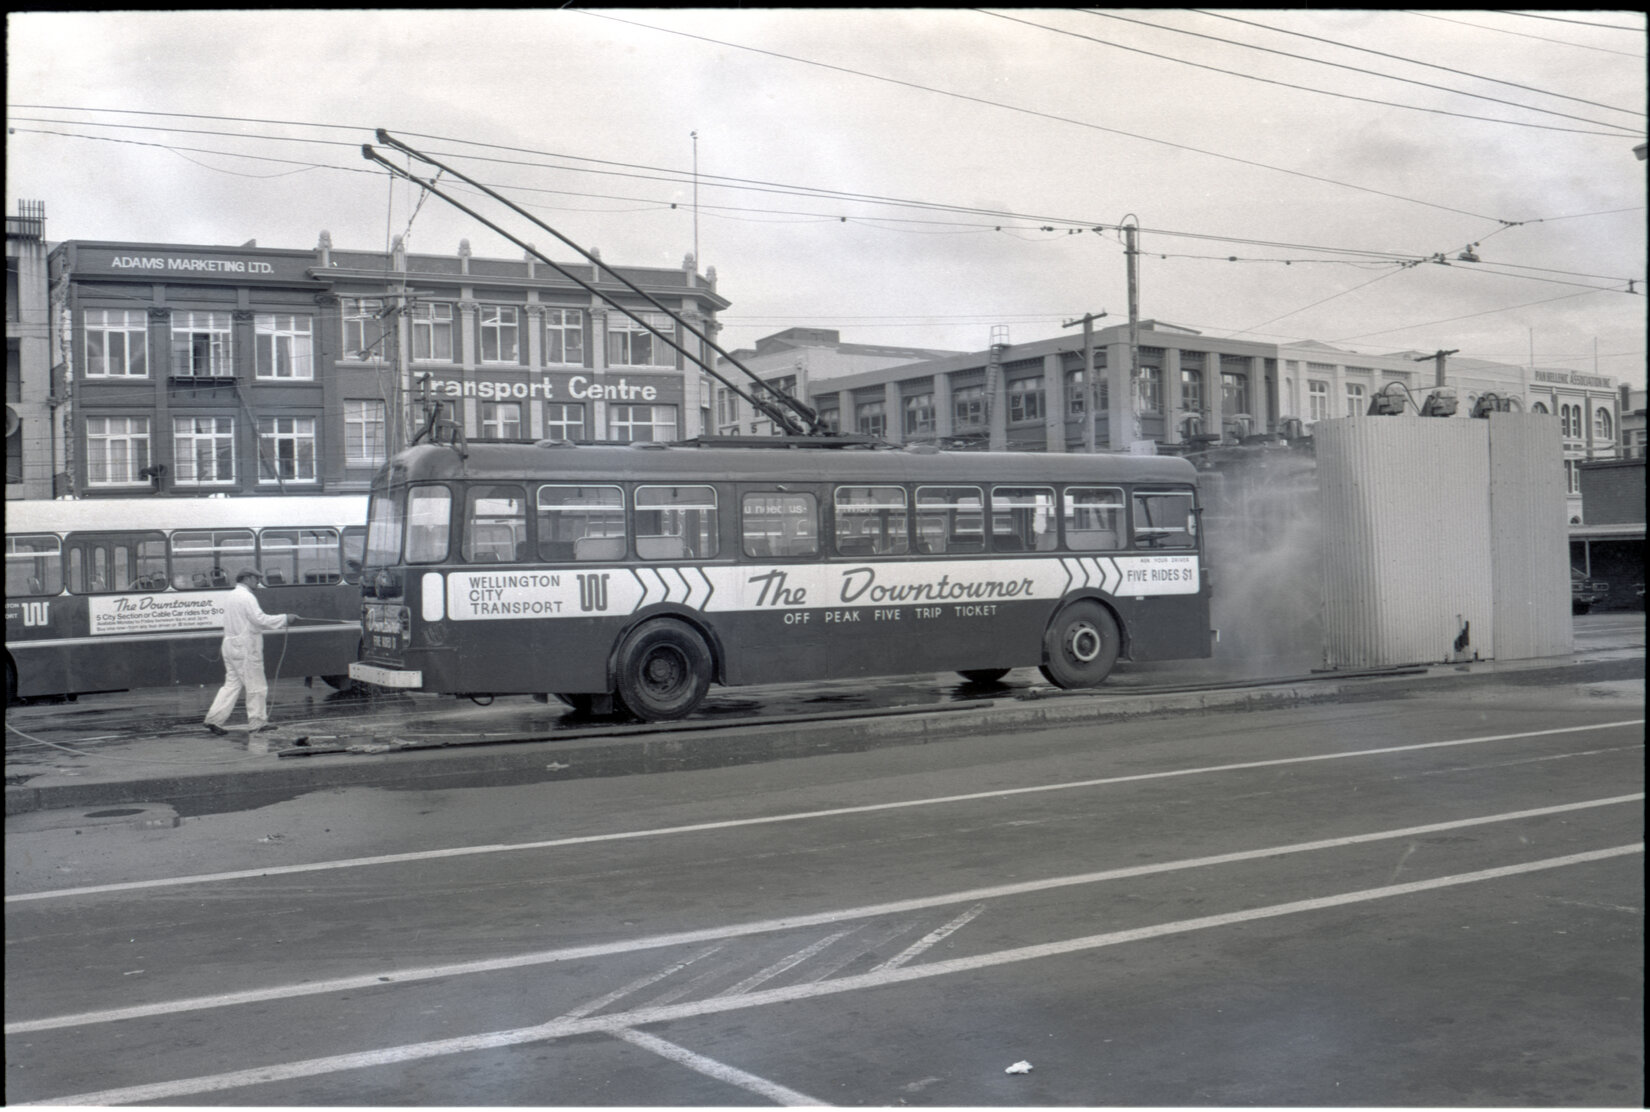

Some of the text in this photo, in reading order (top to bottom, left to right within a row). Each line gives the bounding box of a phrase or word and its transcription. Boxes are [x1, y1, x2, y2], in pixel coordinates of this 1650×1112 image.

[112, 257, 275, 274] ADAMS MARKETING LTD.
[413, 371, 657, 401] Transport Centre
[468, 575, 560, 588] WELLINGTON
[1127, 568, 1193, 582] FIVE RIDES $1
[748, 567, 1034, 606] The Downtowner
[469, 589, 504, 602] CITY
[113, 596, 214, 612] The Downtowner
[470, 601, 563, 615] TRANSPORT
[102, 613, 116, 621] City
[117, 612, 143, 620] Section
[152, 610, 171, 618] Cable
[172, 609, 184, 617] Car
[184, 608, 201, 616] rides
[784, 605, 998, 625] OFF PEAK FIVE TRIP TICKET
